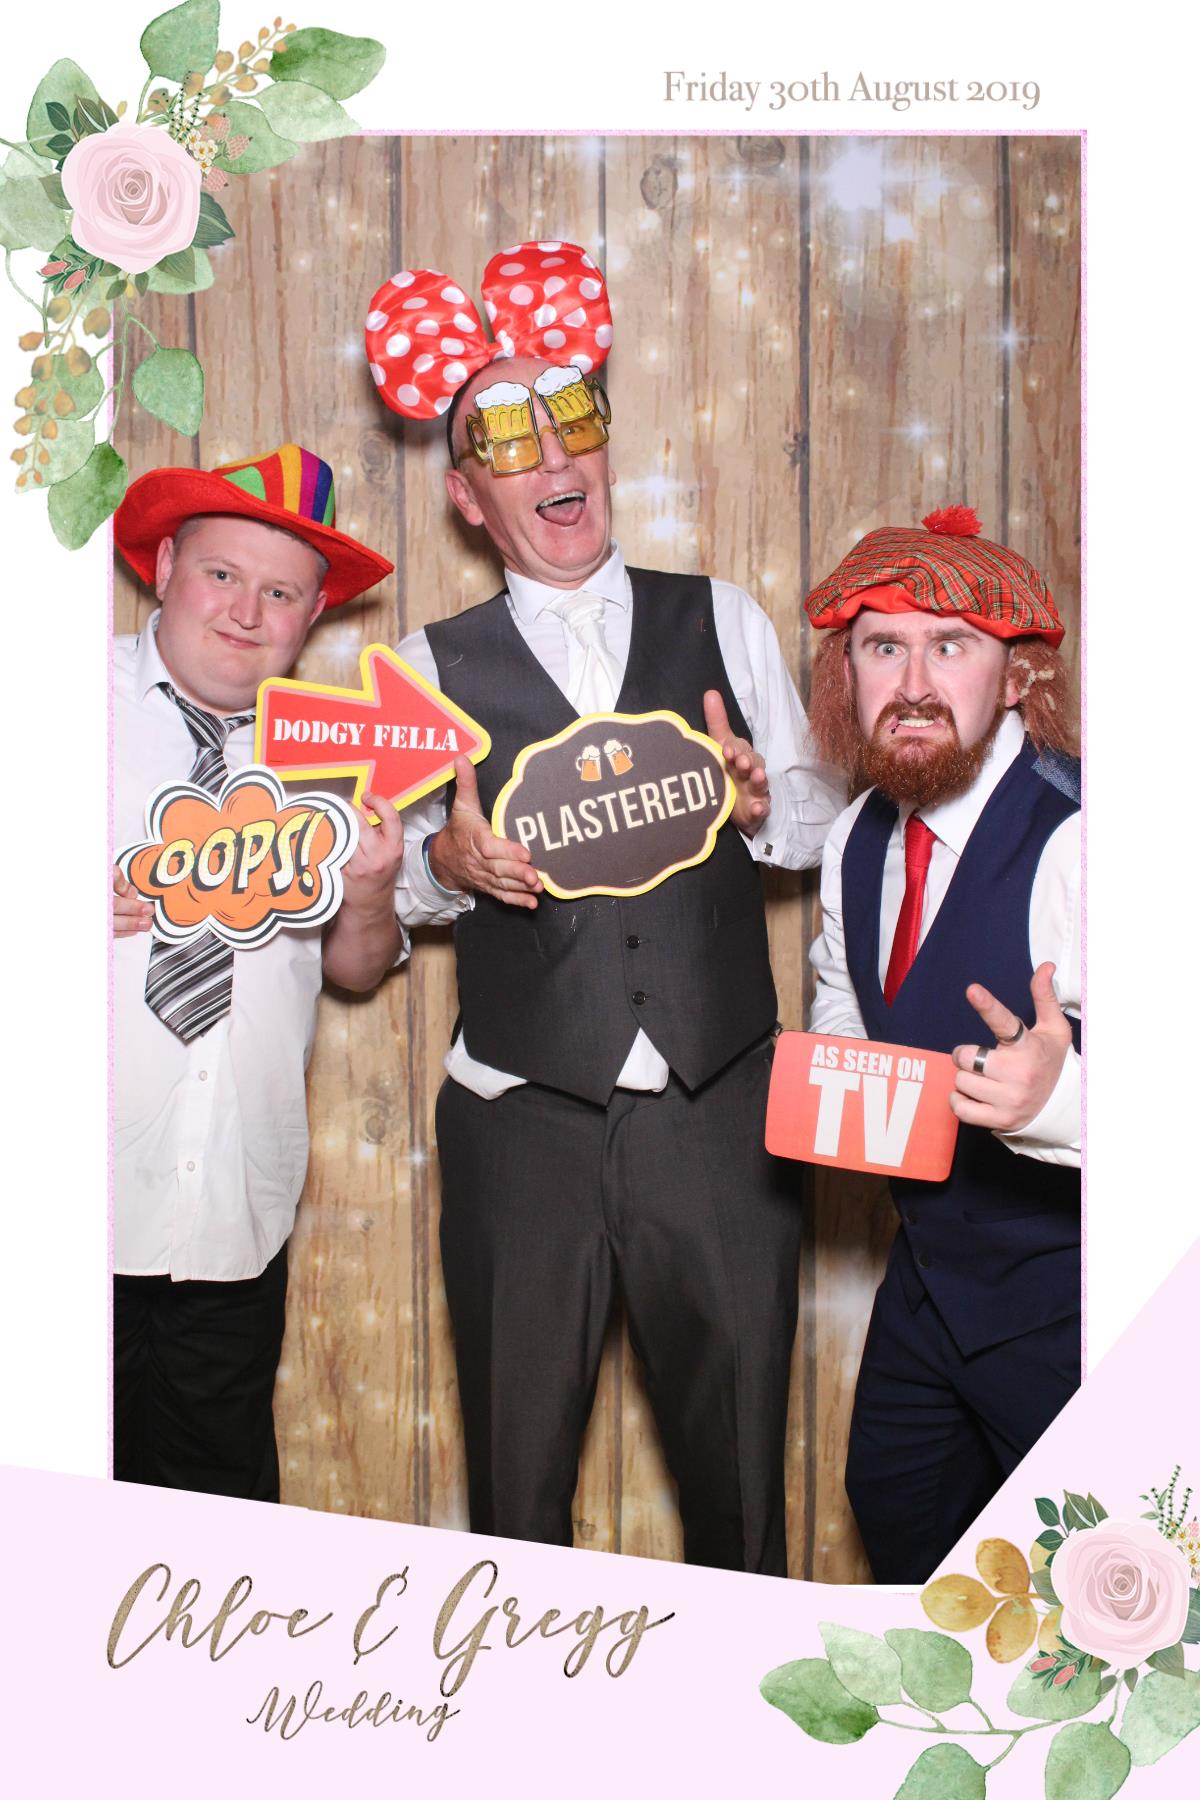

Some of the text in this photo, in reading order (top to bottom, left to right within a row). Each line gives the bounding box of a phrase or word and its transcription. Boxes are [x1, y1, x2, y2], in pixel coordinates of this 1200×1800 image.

[273, 718, 460, 752] DODGY FELLA
[514, 766, 719, 852] PLASTERED!
[150, 808, 329, 897] OOPS!
[811, 1044, 926, 1082] AS SEEN ON
[808, 1067, 924, 1168] TV
